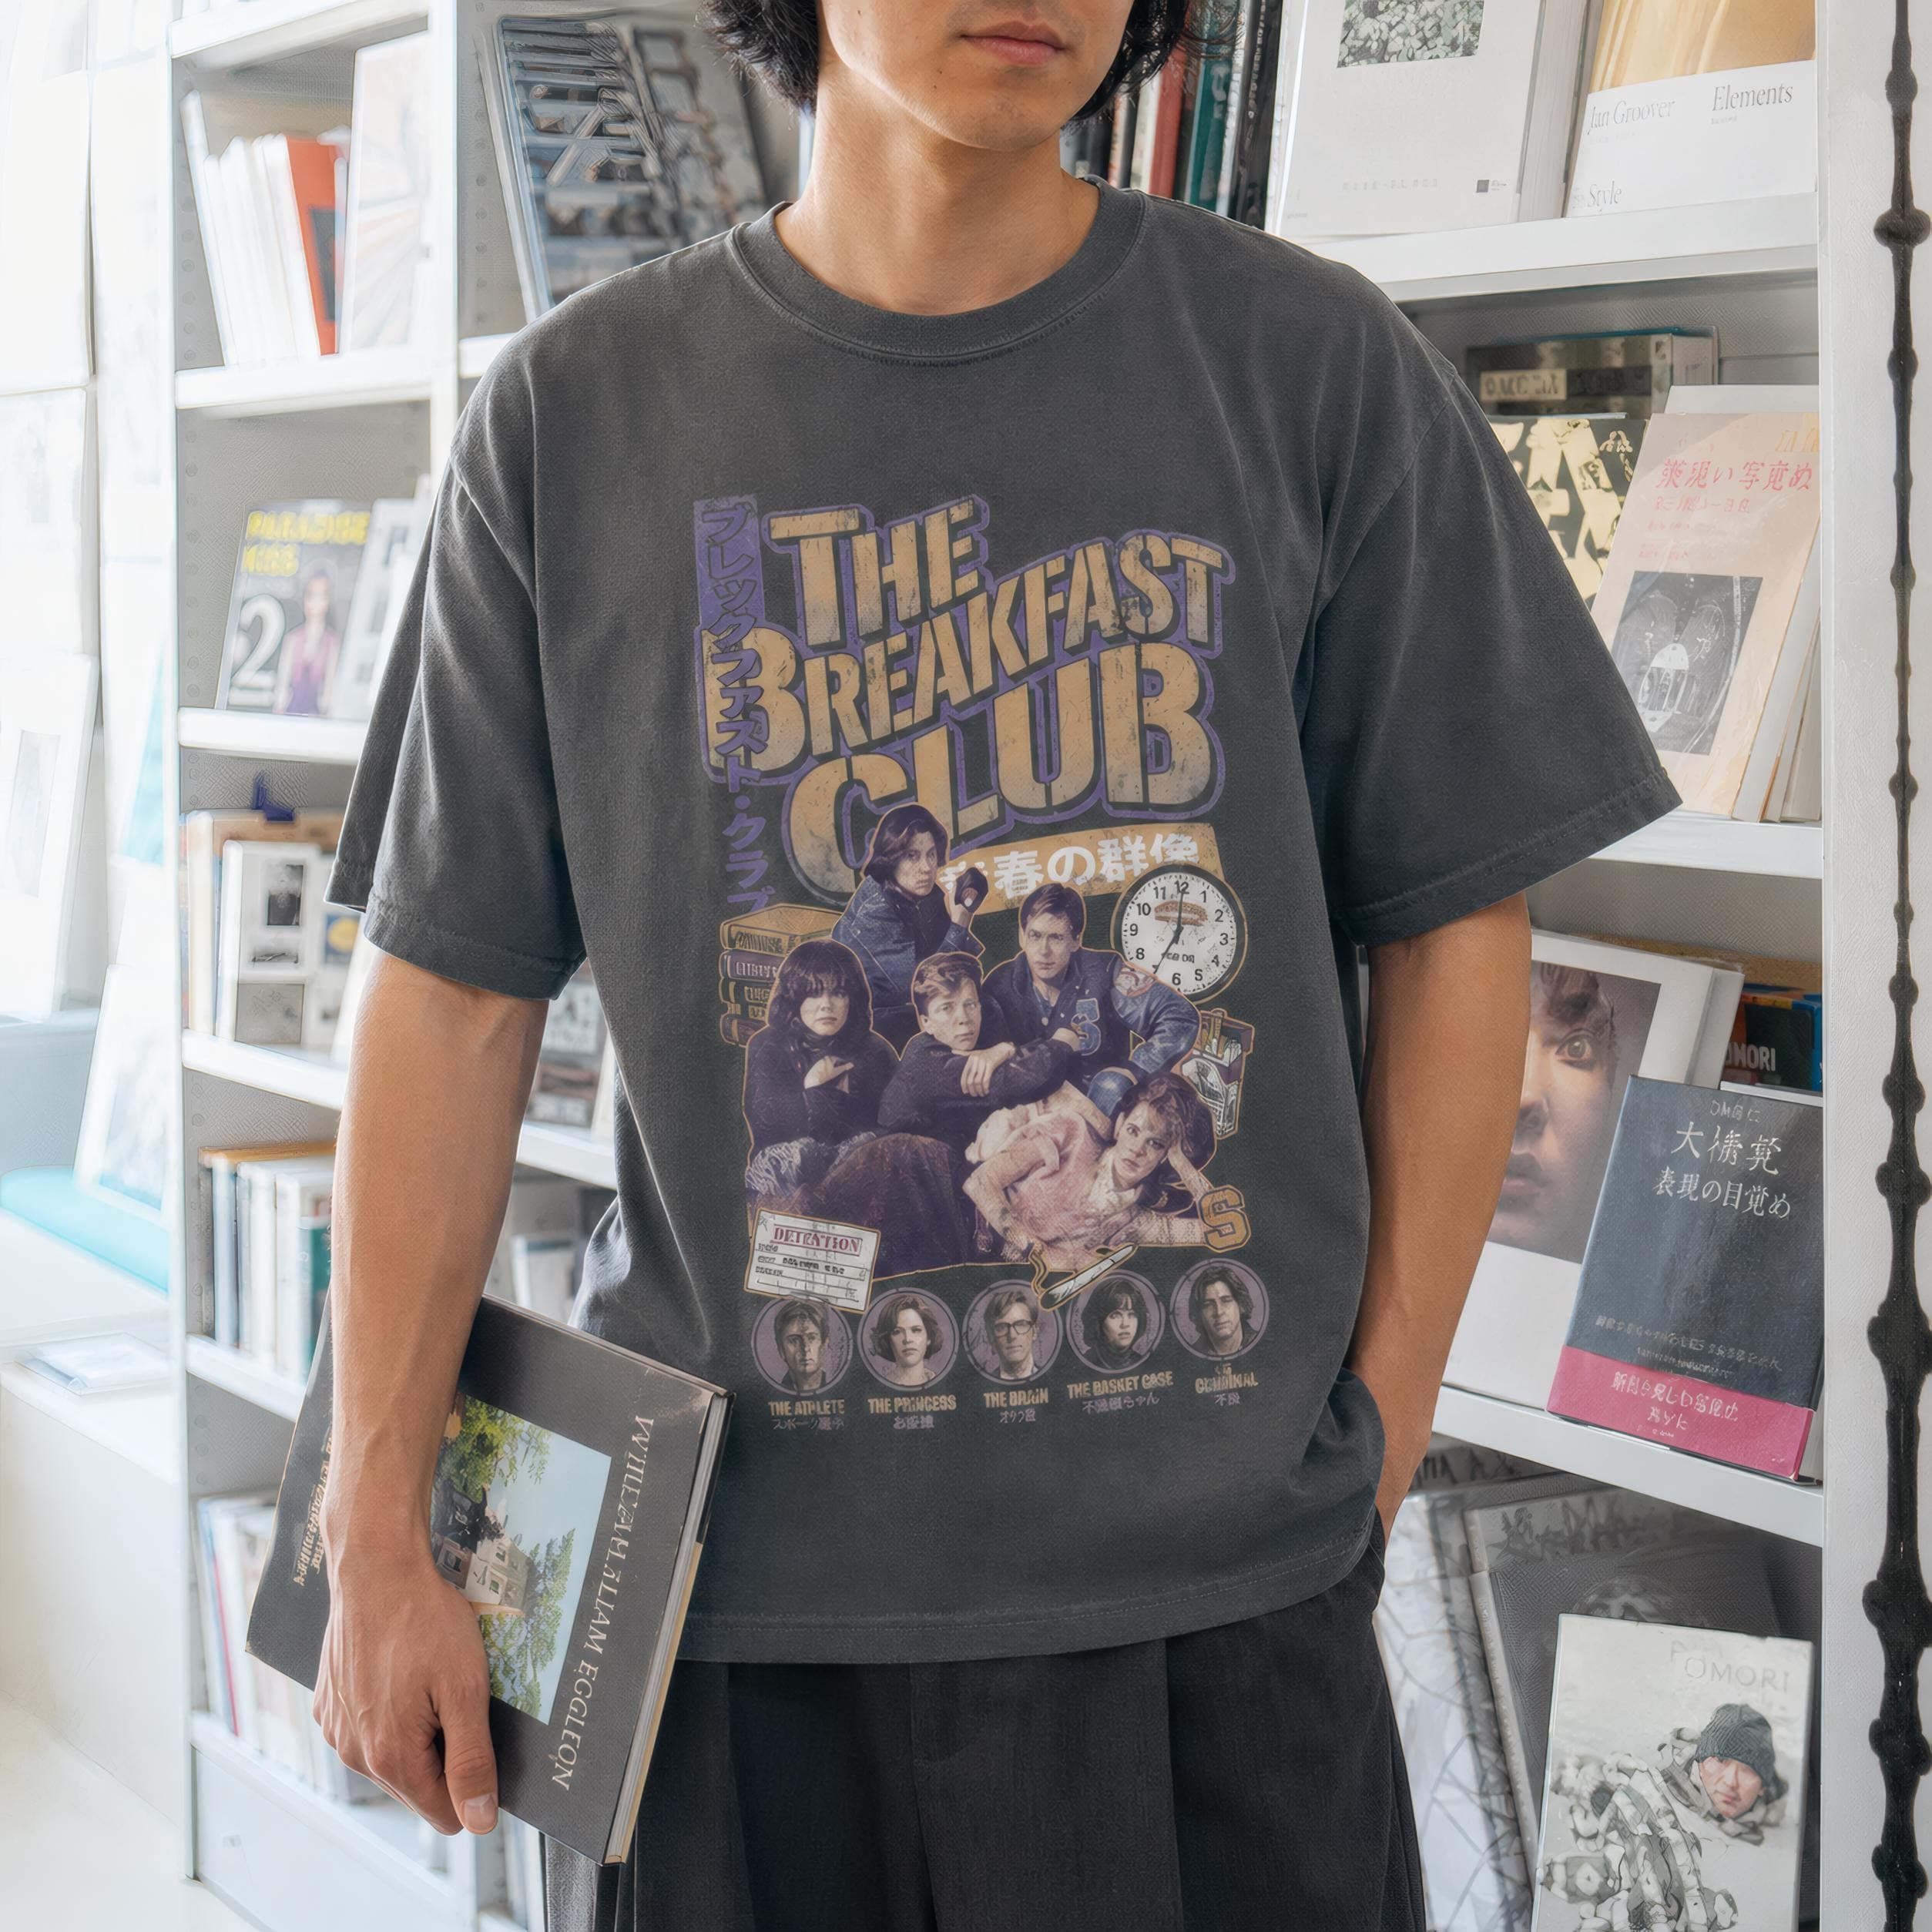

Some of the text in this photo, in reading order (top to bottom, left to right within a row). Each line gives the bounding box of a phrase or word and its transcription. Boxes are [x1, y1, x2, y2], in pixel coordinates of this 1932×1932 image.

[1712, 83, 1793, 111] Elements
[1613, 99, 1675, 126] Groover
[770, 499, 980, 647] THE
[699, 535, 1223, 772] BREAKFAST
[789, 642, 1213, 895] CLUB
[1153, 887, 1166, 900] 11
[1137, 902, 1151, 916] 10
[1215, 909, 1224, 922] 2
[1129, 923, 1139, 936] 9
[1219, 932, 1229, 946] 3
[1135, 948, 1145, 960] 8
[1172, 973, 1182, 986] 6
[1199, 1186, 1250, 1253] S
[1067, 1382, 1092, 1399] THE
[867, 1398, 892, 1414] THE
[983, 1392, 1008, 1408] THE
[768, 1401, 792, 1416] THE
